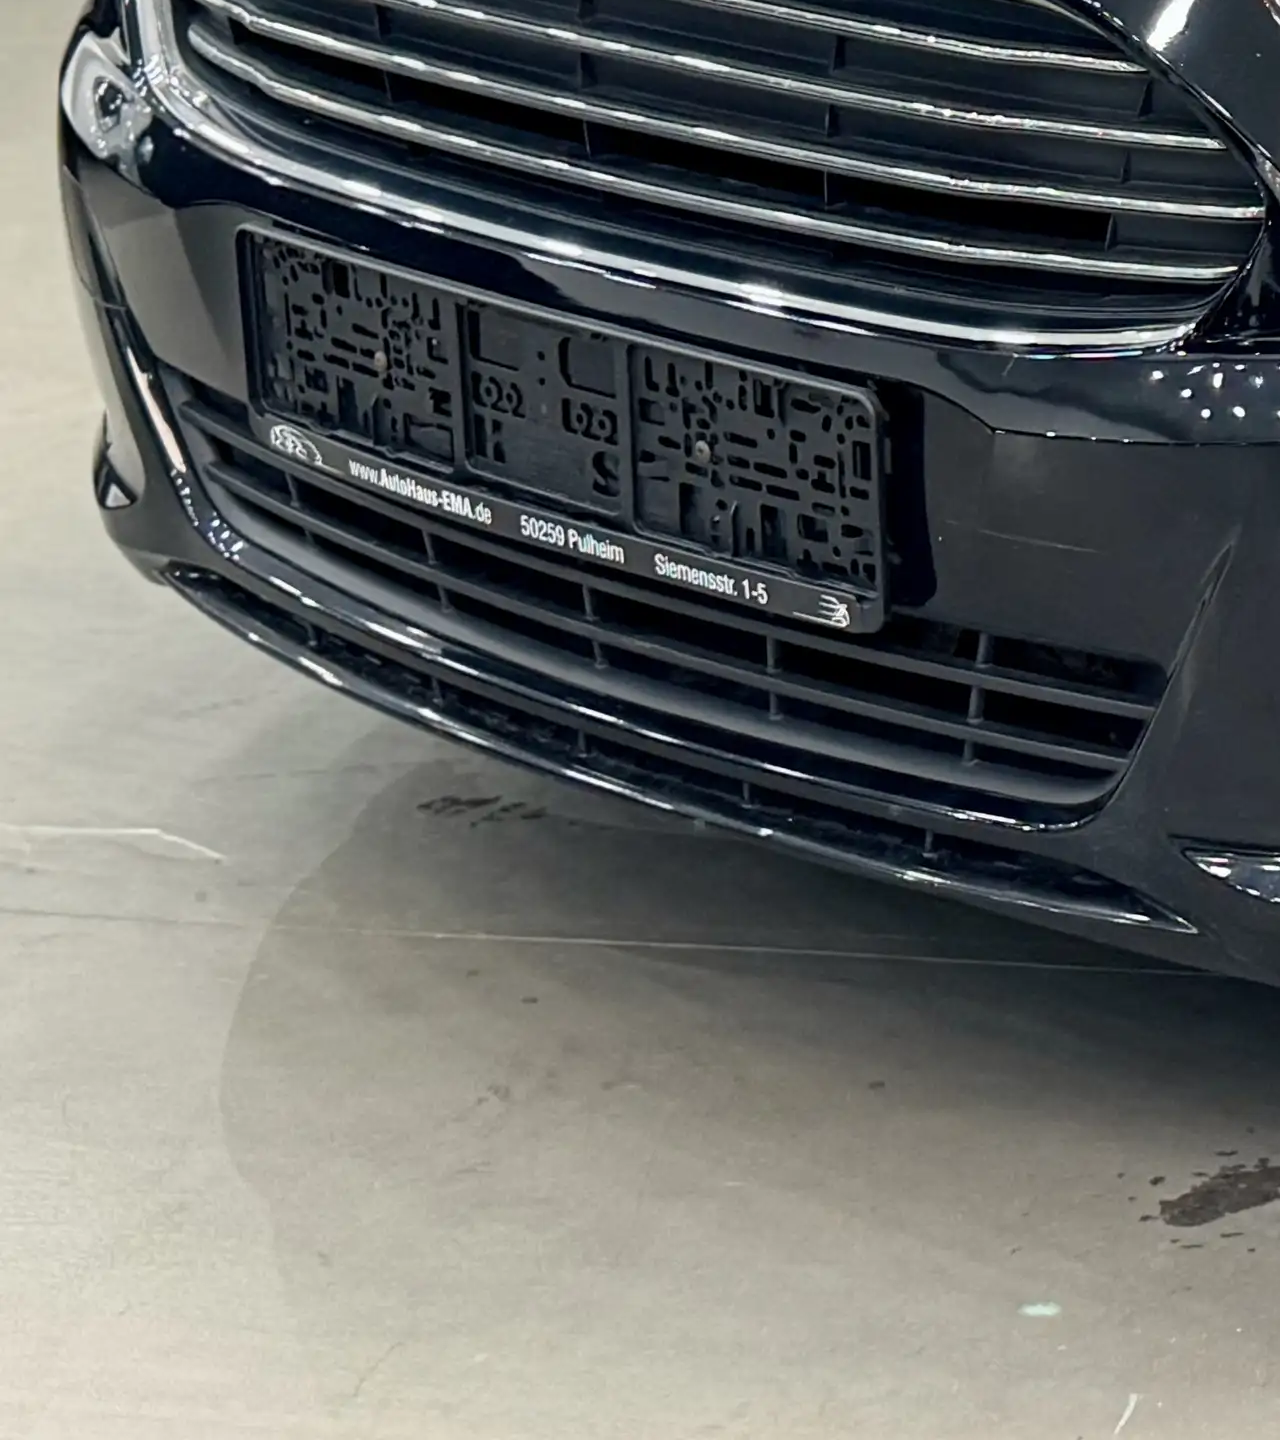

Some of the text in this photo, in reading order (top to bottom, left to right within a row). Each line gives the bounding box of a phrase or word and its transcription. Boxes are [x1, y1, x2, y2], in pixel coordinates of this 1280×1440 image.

[348, 458, 769, 605] www.AutoHaus-EMA.de 50259 Pulheim Siemensstr. 1-5
